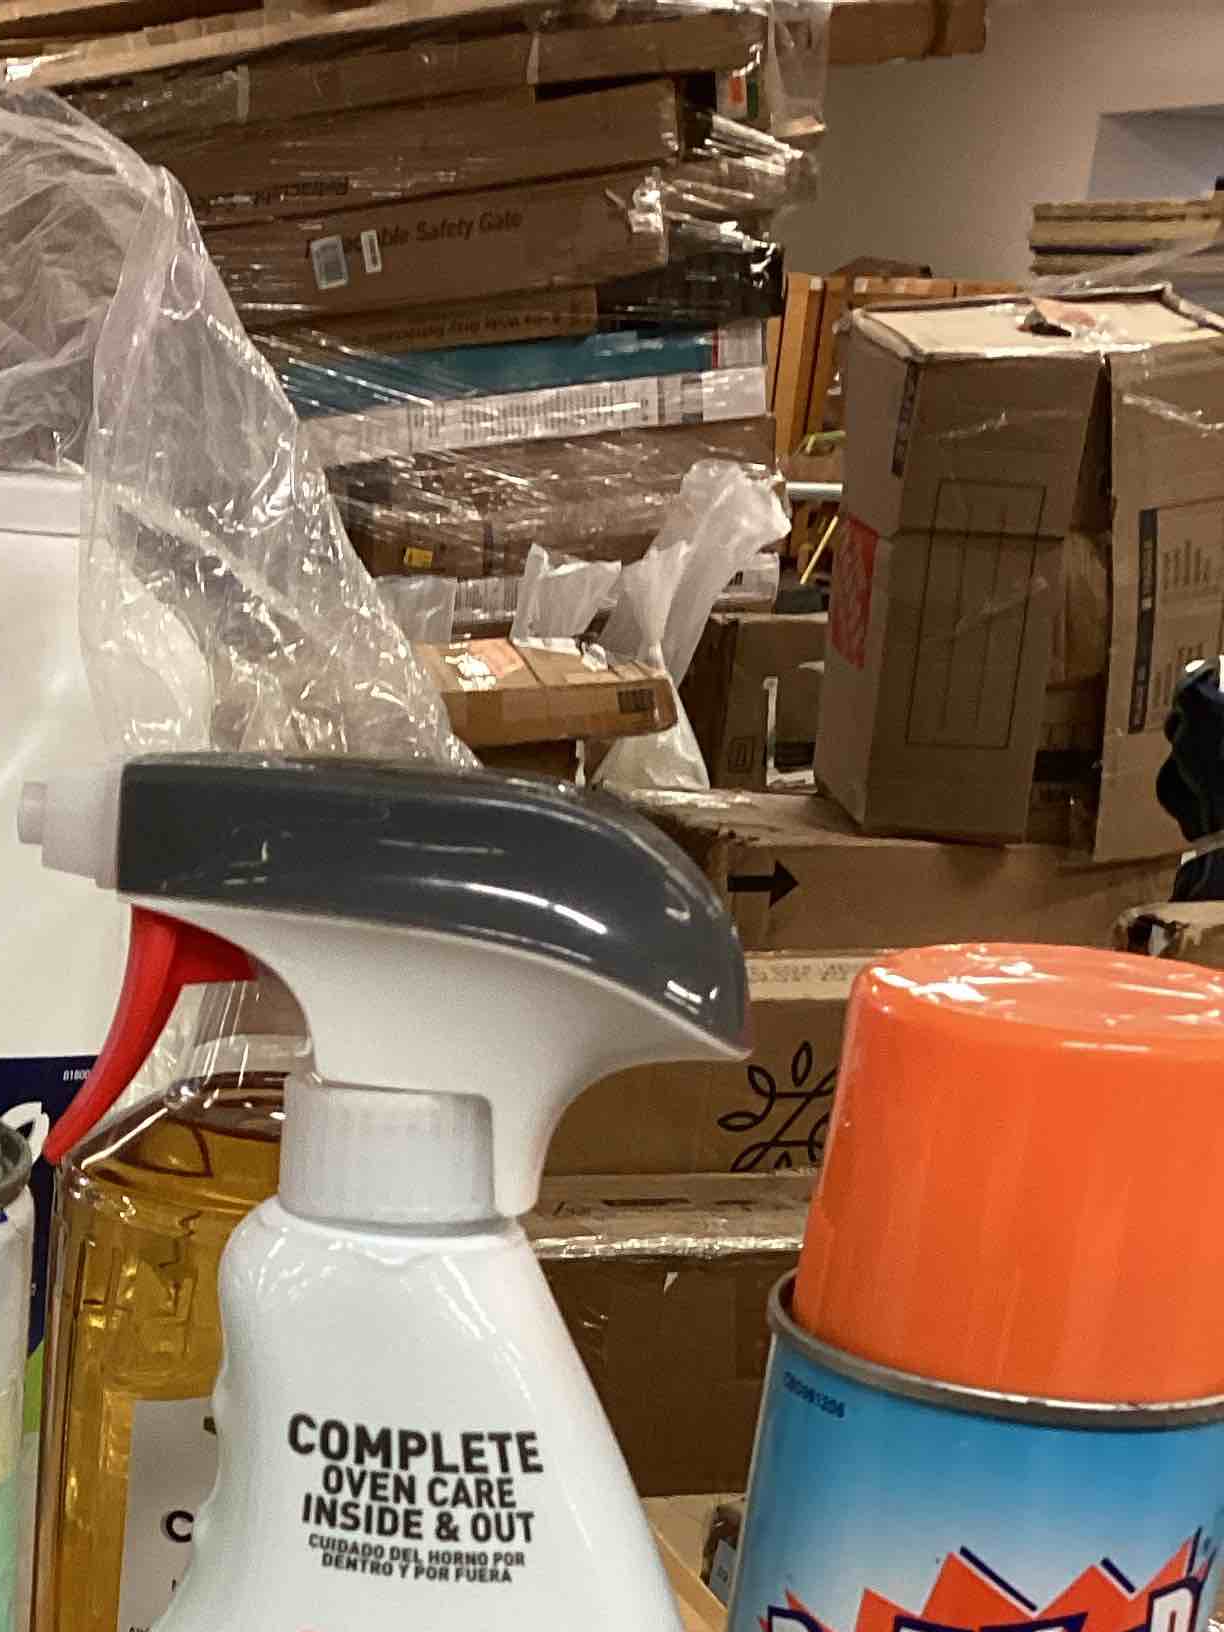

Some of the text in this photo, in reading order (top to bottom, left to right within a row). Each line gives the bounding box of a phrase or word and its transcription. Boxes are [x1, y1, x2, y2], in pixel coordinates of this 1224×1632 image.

[416, 213, 476, 244] Safety
[479, 207, 524, 233] Gate
[287, 1412, 544, 1475] COMPLETE
[322, 1464, 517, 1509] OVEN CARE
[302, 1492, 536, 1544] INSIDE & OUT
[307, 1532, 526, 1568] CUIDADO DEL HORNO POR
[321, 1553, 514, 1584] DENTRO Y POR FUERA
